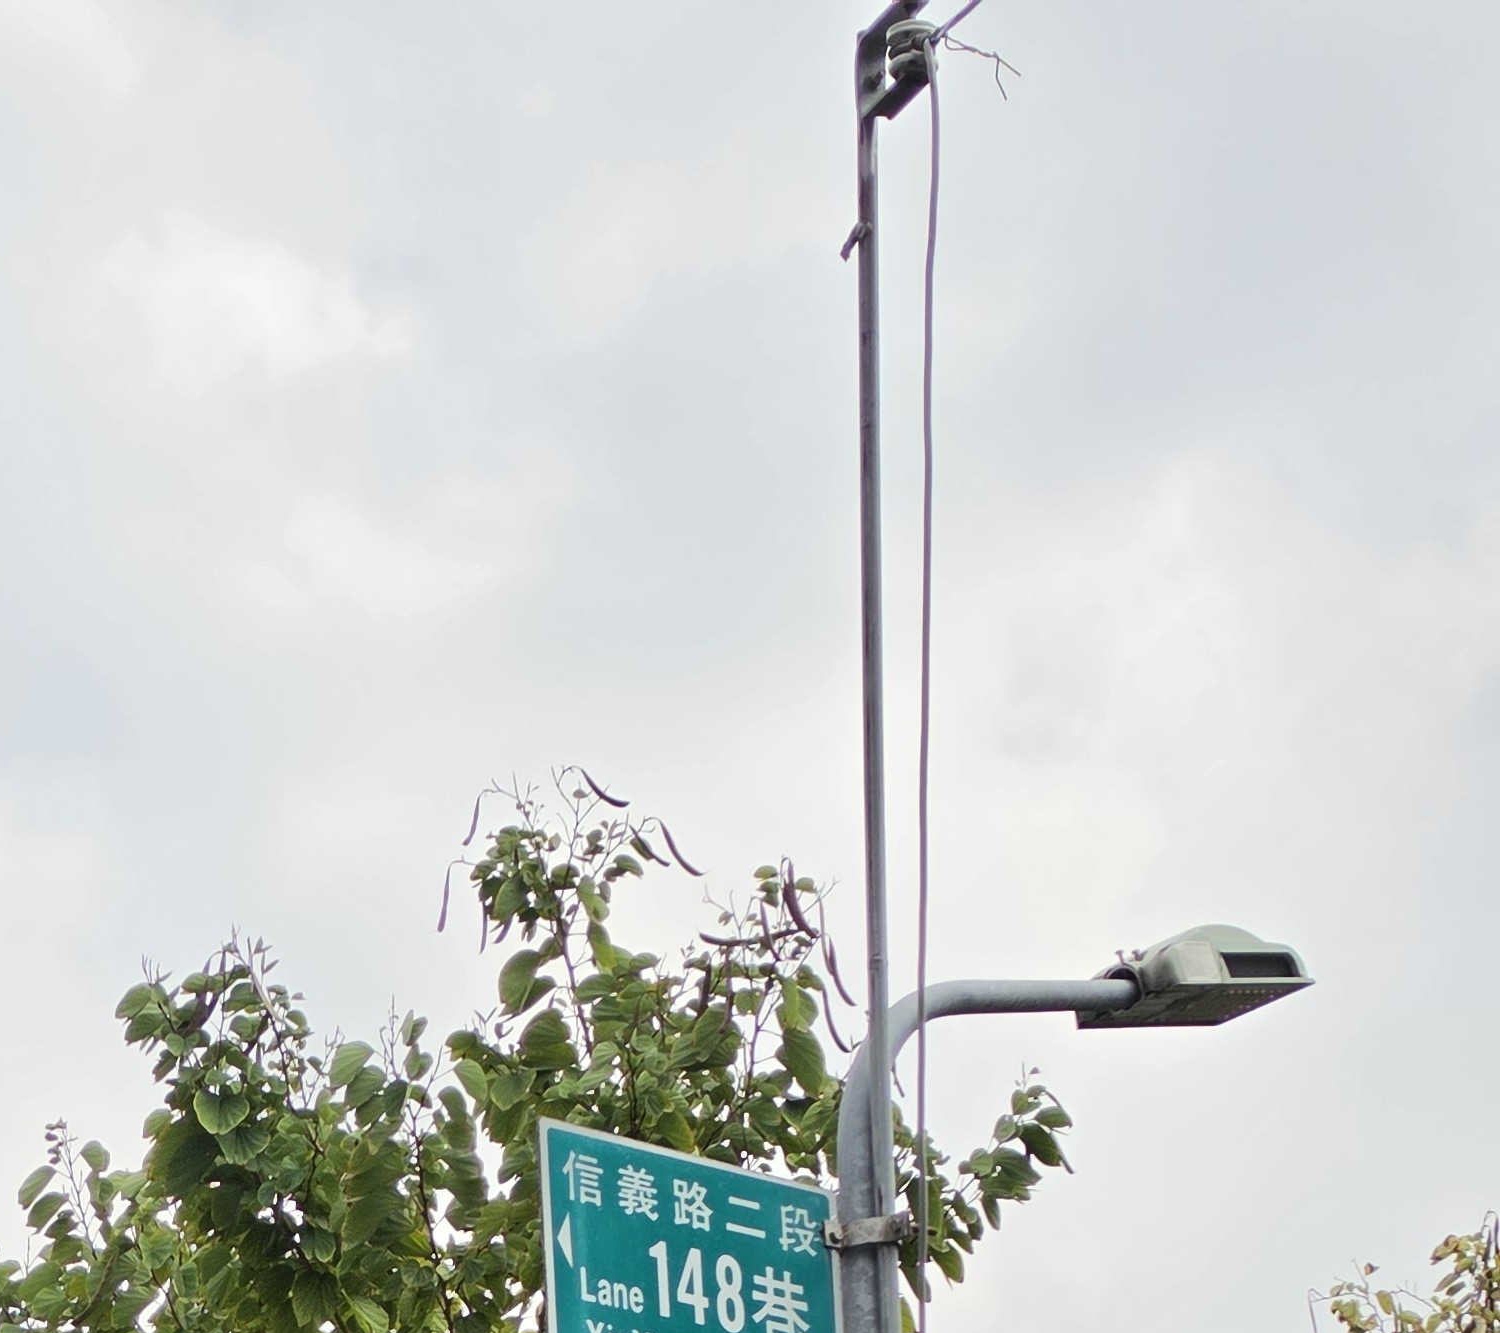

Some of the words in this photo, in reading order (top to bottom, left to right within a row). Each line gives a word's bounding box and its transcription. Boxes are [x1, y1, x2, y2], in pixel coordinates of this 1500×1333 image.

[562, 1150, 819, 1258] 信義路二段
[580, 1266, 645, 1314] Lane
